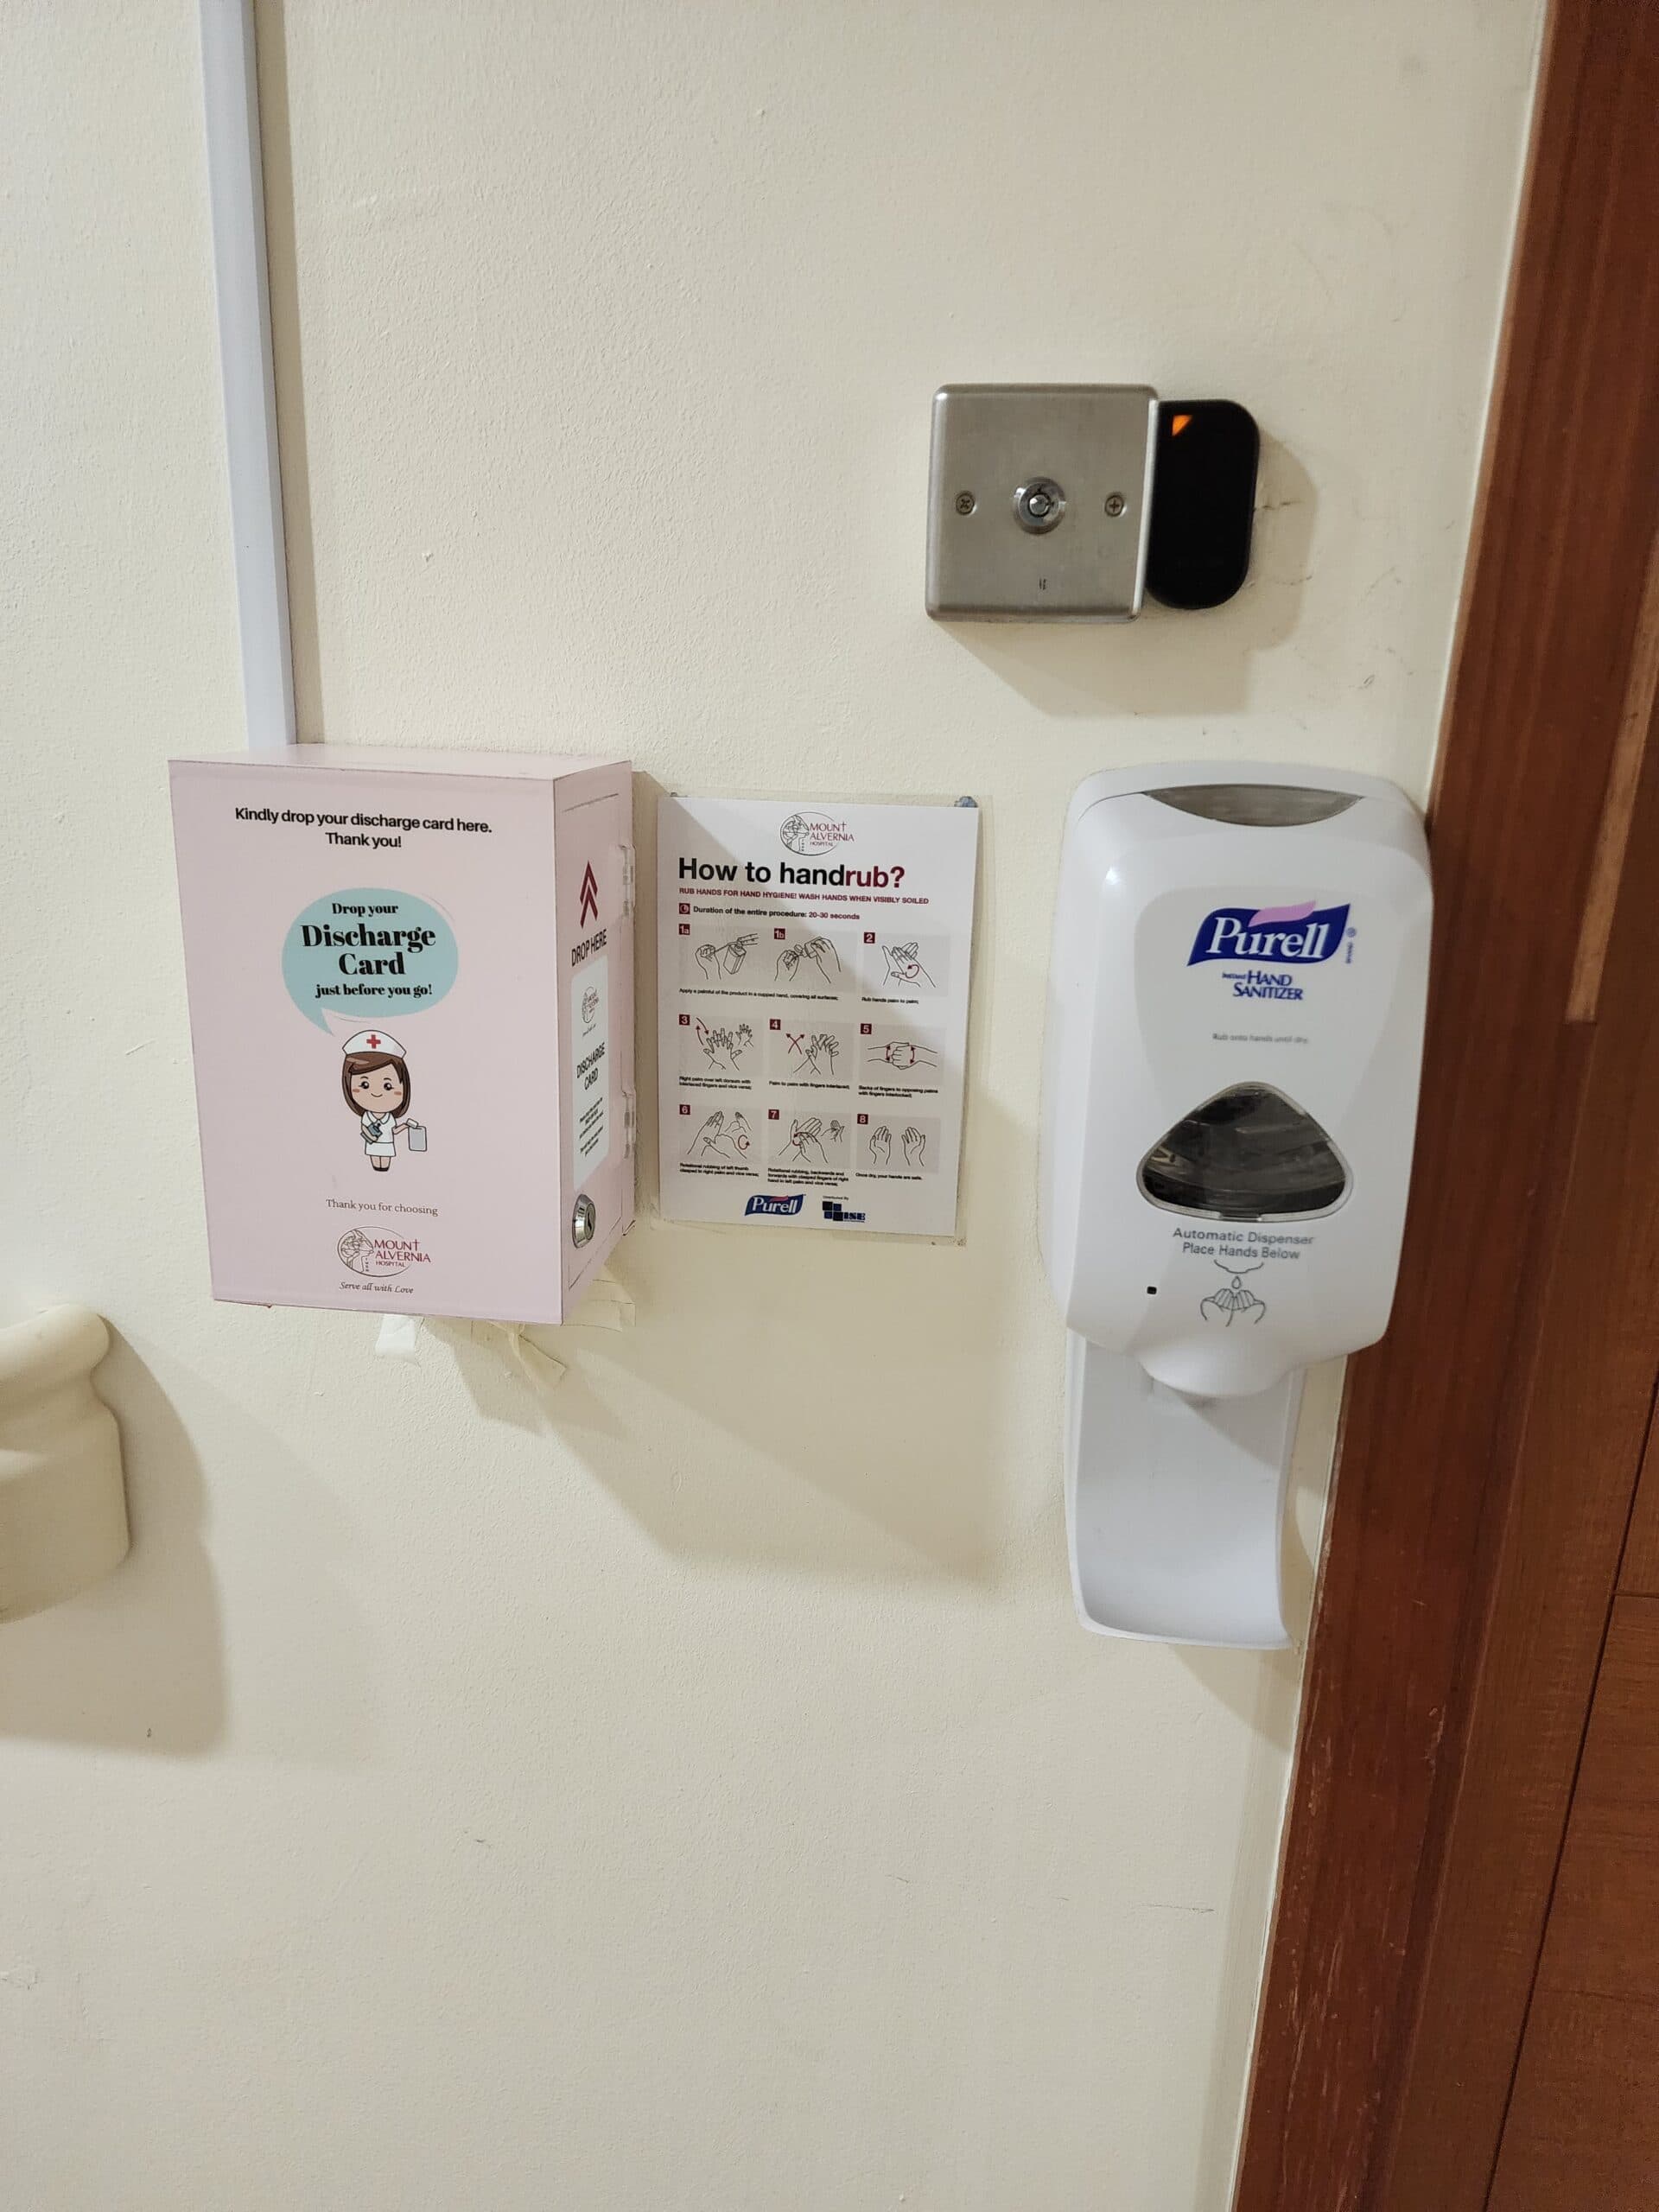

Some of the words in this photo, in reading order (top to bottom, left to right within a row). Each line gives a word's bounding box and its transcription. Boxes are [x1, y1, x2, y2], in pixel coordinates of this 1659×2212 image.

[235, 807, 279, 824] Kindly
[281, 810, 315, 826] drop
[316, 814, 348, 827] your
[350, 812, 421, 831] discharge
[423, 817, 454, 830] card
[457, 818, 493, 833] here.
[810, 822, 848, 833] MOUNT
[325, 832, 370, 846] Thank
[372, 836, 402, 849] you!
[810, 832, 855, 842] ALVERNIA
[678, 857, 737, 881] How
[745, 861, 772, 883] to
[779, 862, 906, 888] handrub?
[762, 891, 797, 899] HYGIENE!
[332, 903, 365, 917] Drop
[367, 905, 398, 917] your
[693, 906, 724, 914] Duration
[768, 909, 807, 918] procedure:
[680, 925, 690, 934] 1a
[775, 930, 785, 939] 1b
[301, 923, 435, 953] Discharge
[866, 933, 874, 943] 2
[1206, 917, 1331, 959] Purell
[571, 939, 589, 967] DROP
[590, 929, 607, 954] HERE
[339, 951, 406, 975] Card
[1247, 969, 1293, 987] HAND
[315, 984, 340, 998] just
[343, 983, 385, 995] before
[388, 987, 410, 998] you
[413, 983, 433, 998] go!
[1233, 982, 1304, 1001] SANITIZER
[681, 1015, 688, 1024] 3
[772, 1020, 779, 1028] 4
[862, 1025, 870, 1033] 5
[576, 1041, 605, 1078] DISCHARGE
[681, 1105, 688, 1114] 6
[771, 1110, 778, 1120] 7
[860, 1115, 867, 1124] 8
[326, 1198, 357, 1210] Thank
[358, 1203, 376, 1211] you
[378, 1202, 392, 1211] for
[394, 1204, 439, 1217] choosing
[751, 1196, 798, 1214] Purell
[1173, 1227, 1244, 1243] Automatic
[1248, 1231, 1314, 1246] Dispenser
[374, 1238, 421, 1251] MOUNT
[1182, 1242, 1215, 1255] Place
[1219, 1244, 1258, 1258] Hands
[1262, 1246, 1301, 1260] Below
[375, 1250, 431, 1262] ALVERNIA
[339, 1281, 360, 1290] Serve
[361, 1282, 373, 1291] all
[374, 1284, 392, 1293] with
[394, 1285, 414, 1294] Love
